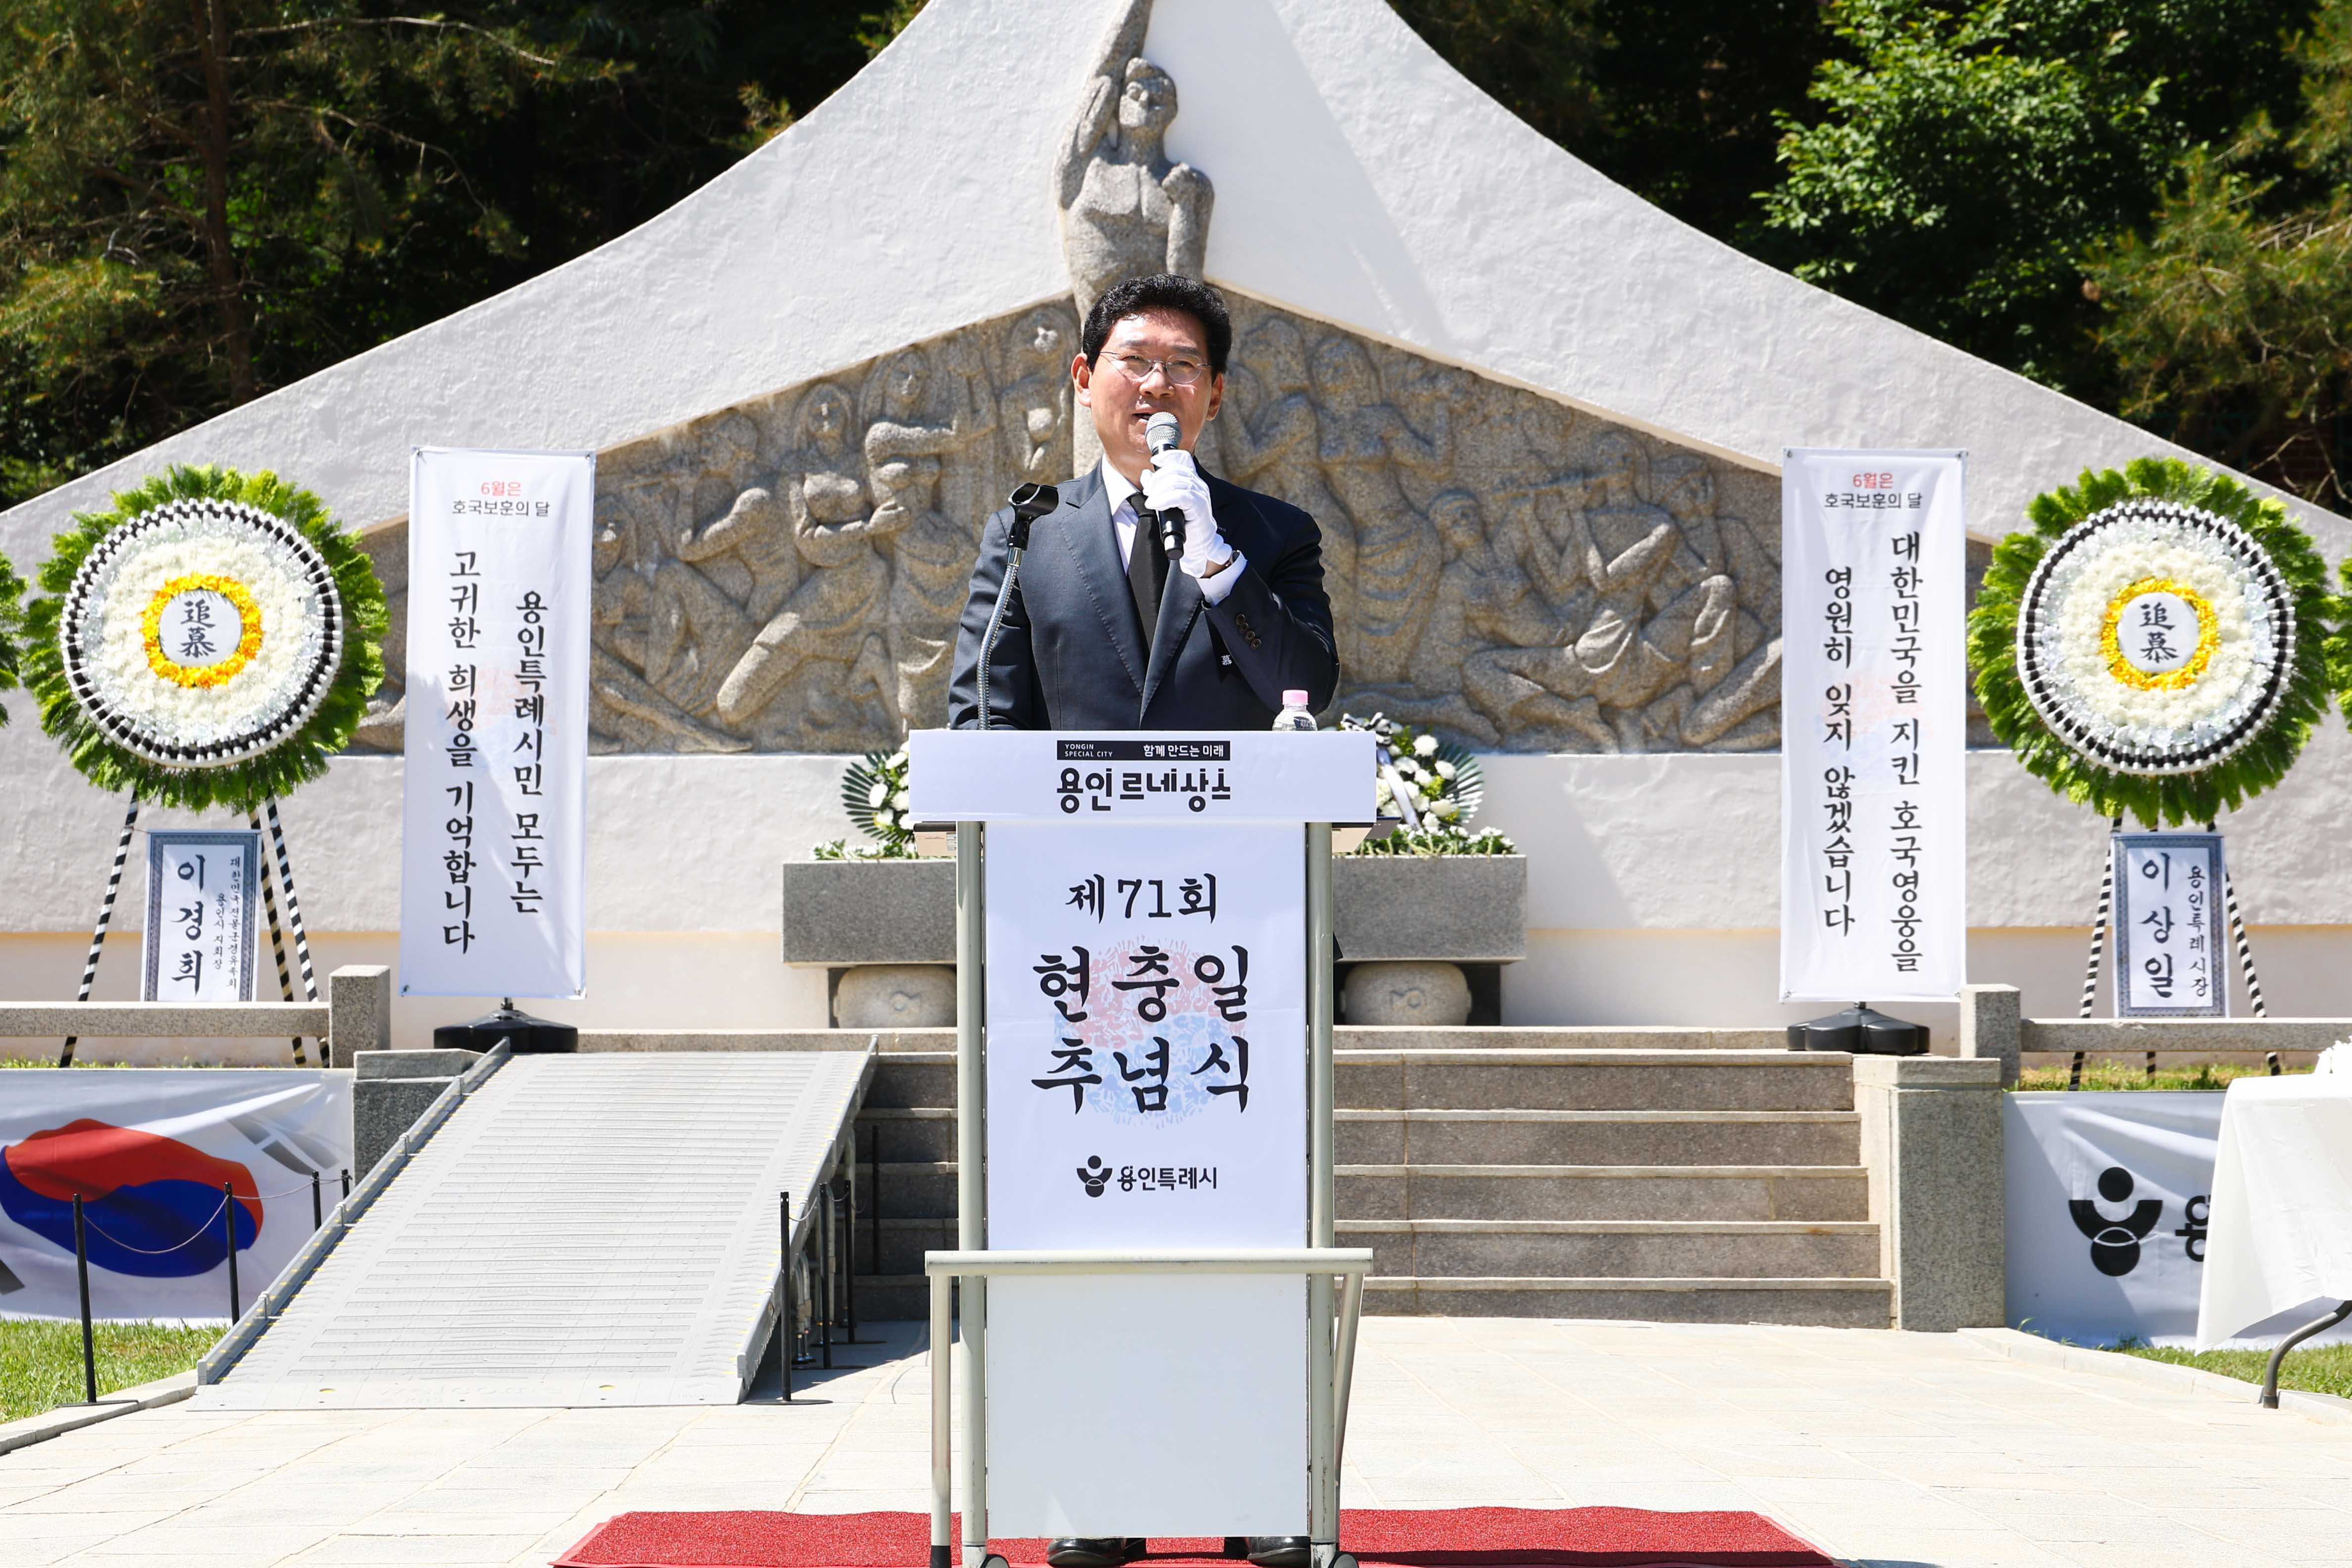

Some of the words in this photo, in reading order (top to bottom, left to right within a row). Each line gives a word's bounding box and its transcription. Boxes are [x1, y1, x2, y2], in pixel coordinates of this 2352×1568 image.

[453, 501, 528, 516] 호국보훈의
[536, 502, 549, 516] 달
[481, 481, 520, 496] 6월은
[1825, 493, 1900, 509] 호국보훈의
[1908, 493, 1922, 508] 달
[1854, 473, 1892, 489] 6월은
[180, 601, 216, 658] 追慕
[449, 552, 481, 648] 고귀한
[1824, 566, 1852, 668] 영원히
[1891, 531, 1923, 704] 대한민국을
[2140, 602, 2179, 663] 追慕
[446, 665, 478, 767] 희생을
[514, 591, 548, 795] 용인특례시민
[1824, 684, 1851, 751] 잊지
[1144, 745, 1165, 757] 함께
[1168, 745, 1199, 757] 만드는
[1203, 745, 1223, 757] 미래
[1891, 718, 1919, 785] 지킨
[443, 781, 476, 954] 기억합니다
[511, 813, 544, 912] 모두는
[1823, 766, 1855, 936] 않겠습니다
[1891, 801, 1922, 971] 호국영웅을
[172, 854, 205, 994] 이경희
[1066, 873, 1216, 924] 제71회
[2139, 852, 2175, 998] 이상일
[2187, 865, 2209, 997] 용인특례시장
[1033, 945, 1248, 1022] 현충일
[1031, 1036, 1249, 1114] 추념식
[1117, 1166, 1216, 1192] 용인특례시
